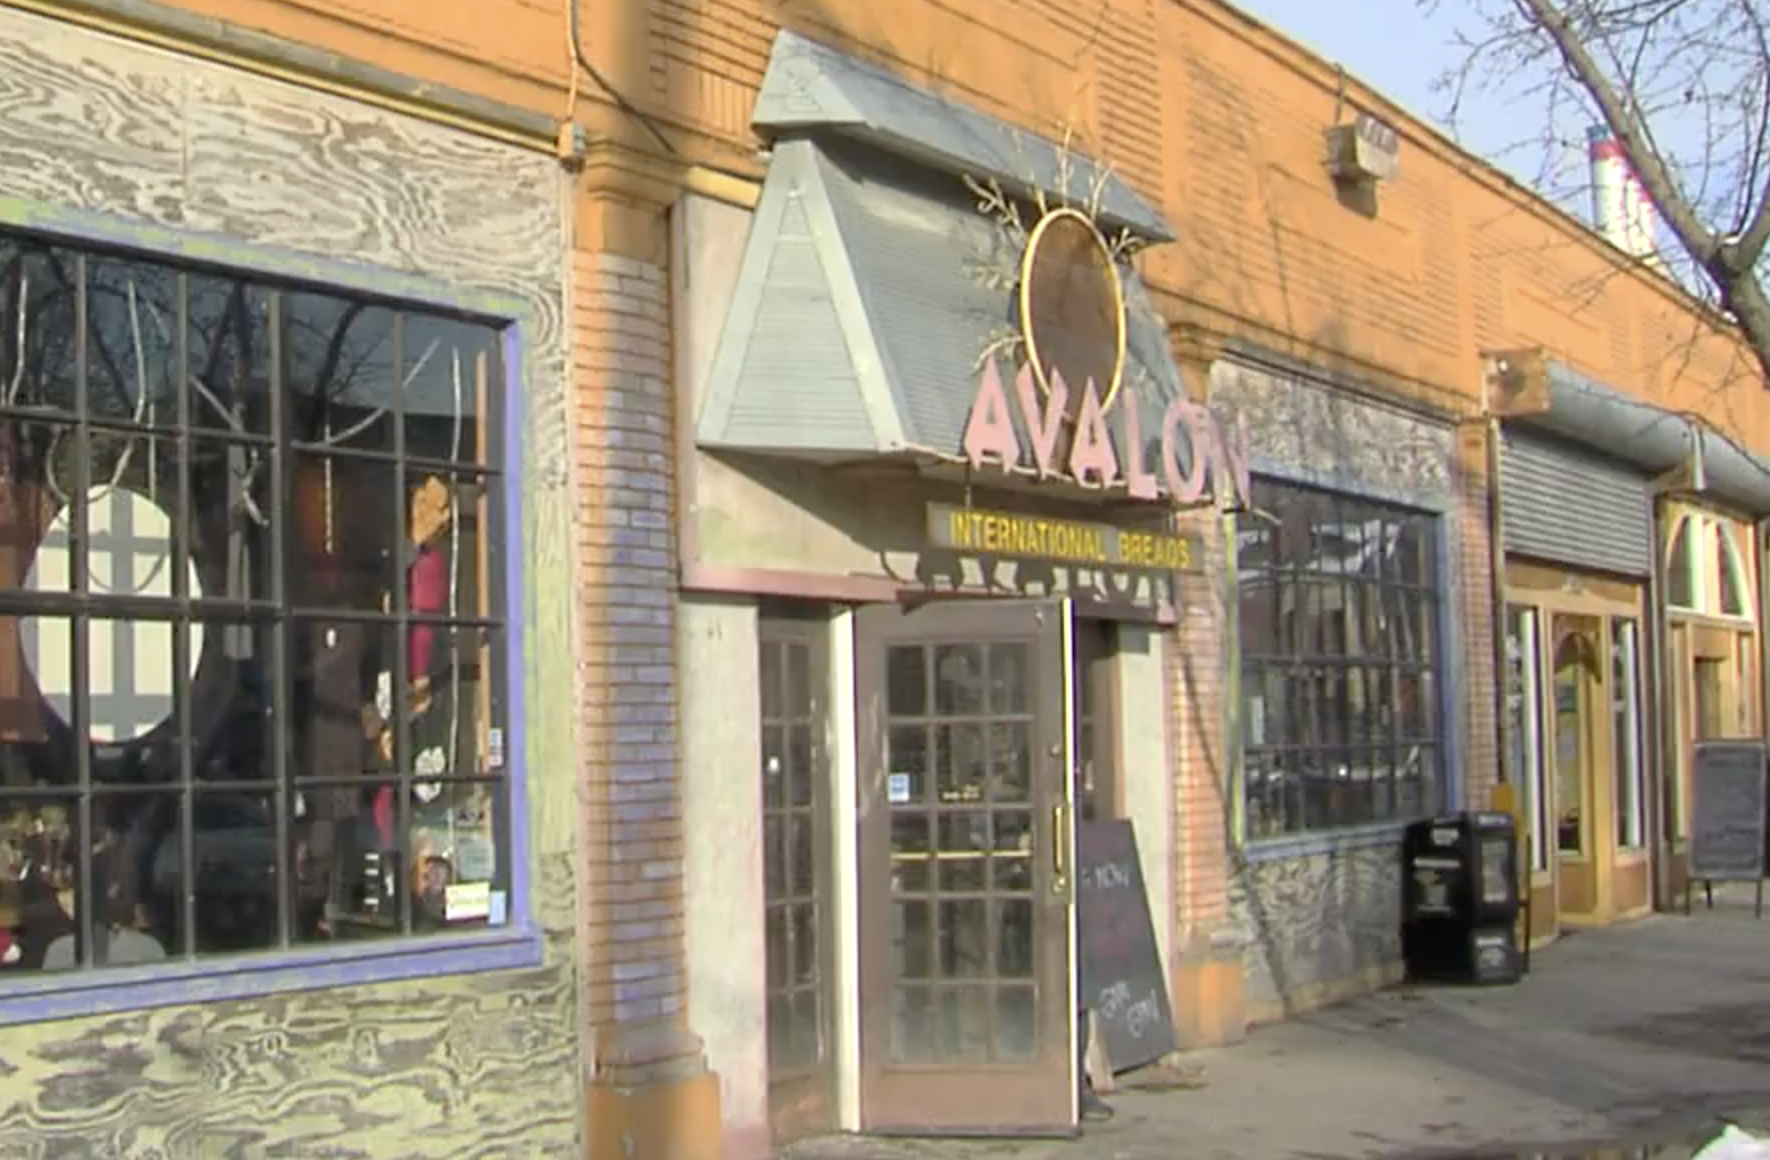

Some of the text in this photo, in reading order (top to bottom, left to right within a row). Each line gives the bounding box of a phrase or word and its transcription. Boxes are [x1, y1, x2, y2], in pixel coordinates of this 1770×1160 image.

[965, 357, 1249, 511] AVALON
[951, 512, 1190, 568] INTERNATIONAL BREADS
